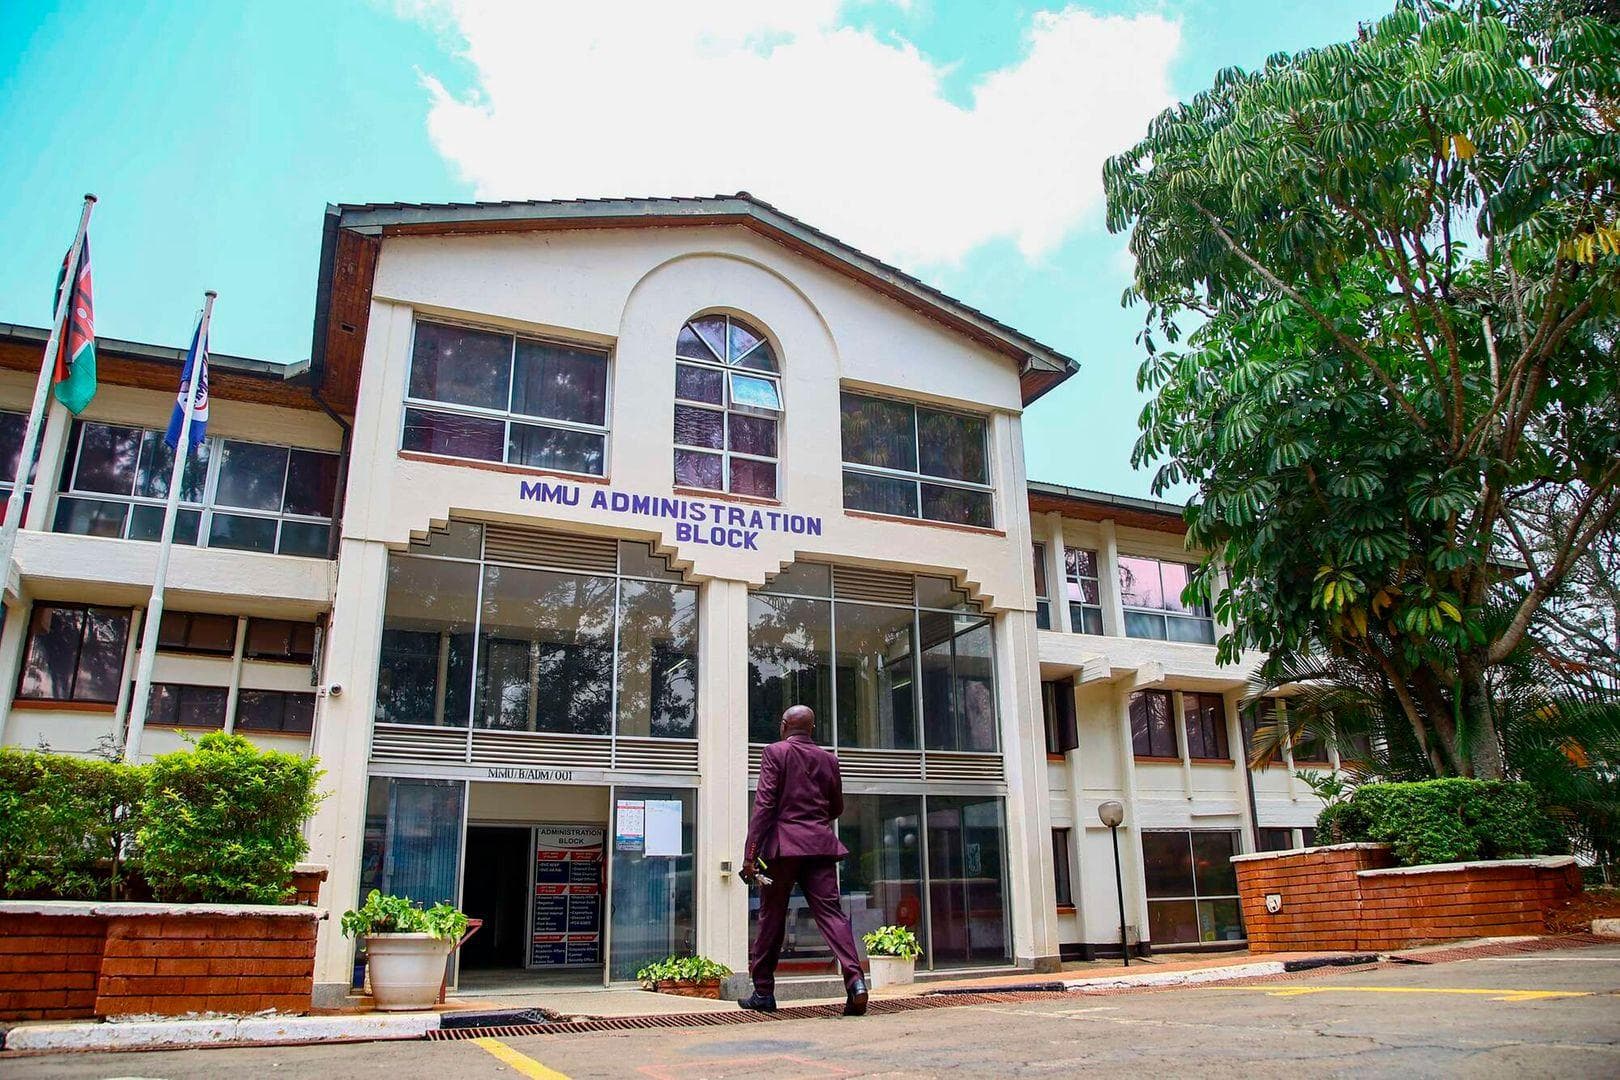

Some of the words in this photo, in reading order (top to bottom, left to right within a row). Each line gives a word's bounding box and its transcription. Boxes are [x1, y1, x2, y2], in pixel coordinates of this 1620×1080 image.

[519, 480, 580, 506] MMU
[590, 490, 822, 536] ADMINISTRATION
[675, 522, 759, 550] BLOCK
[539, 827, 602, 837] ADMINISTRATION
[558, 837, 585, 845] BLOCK
